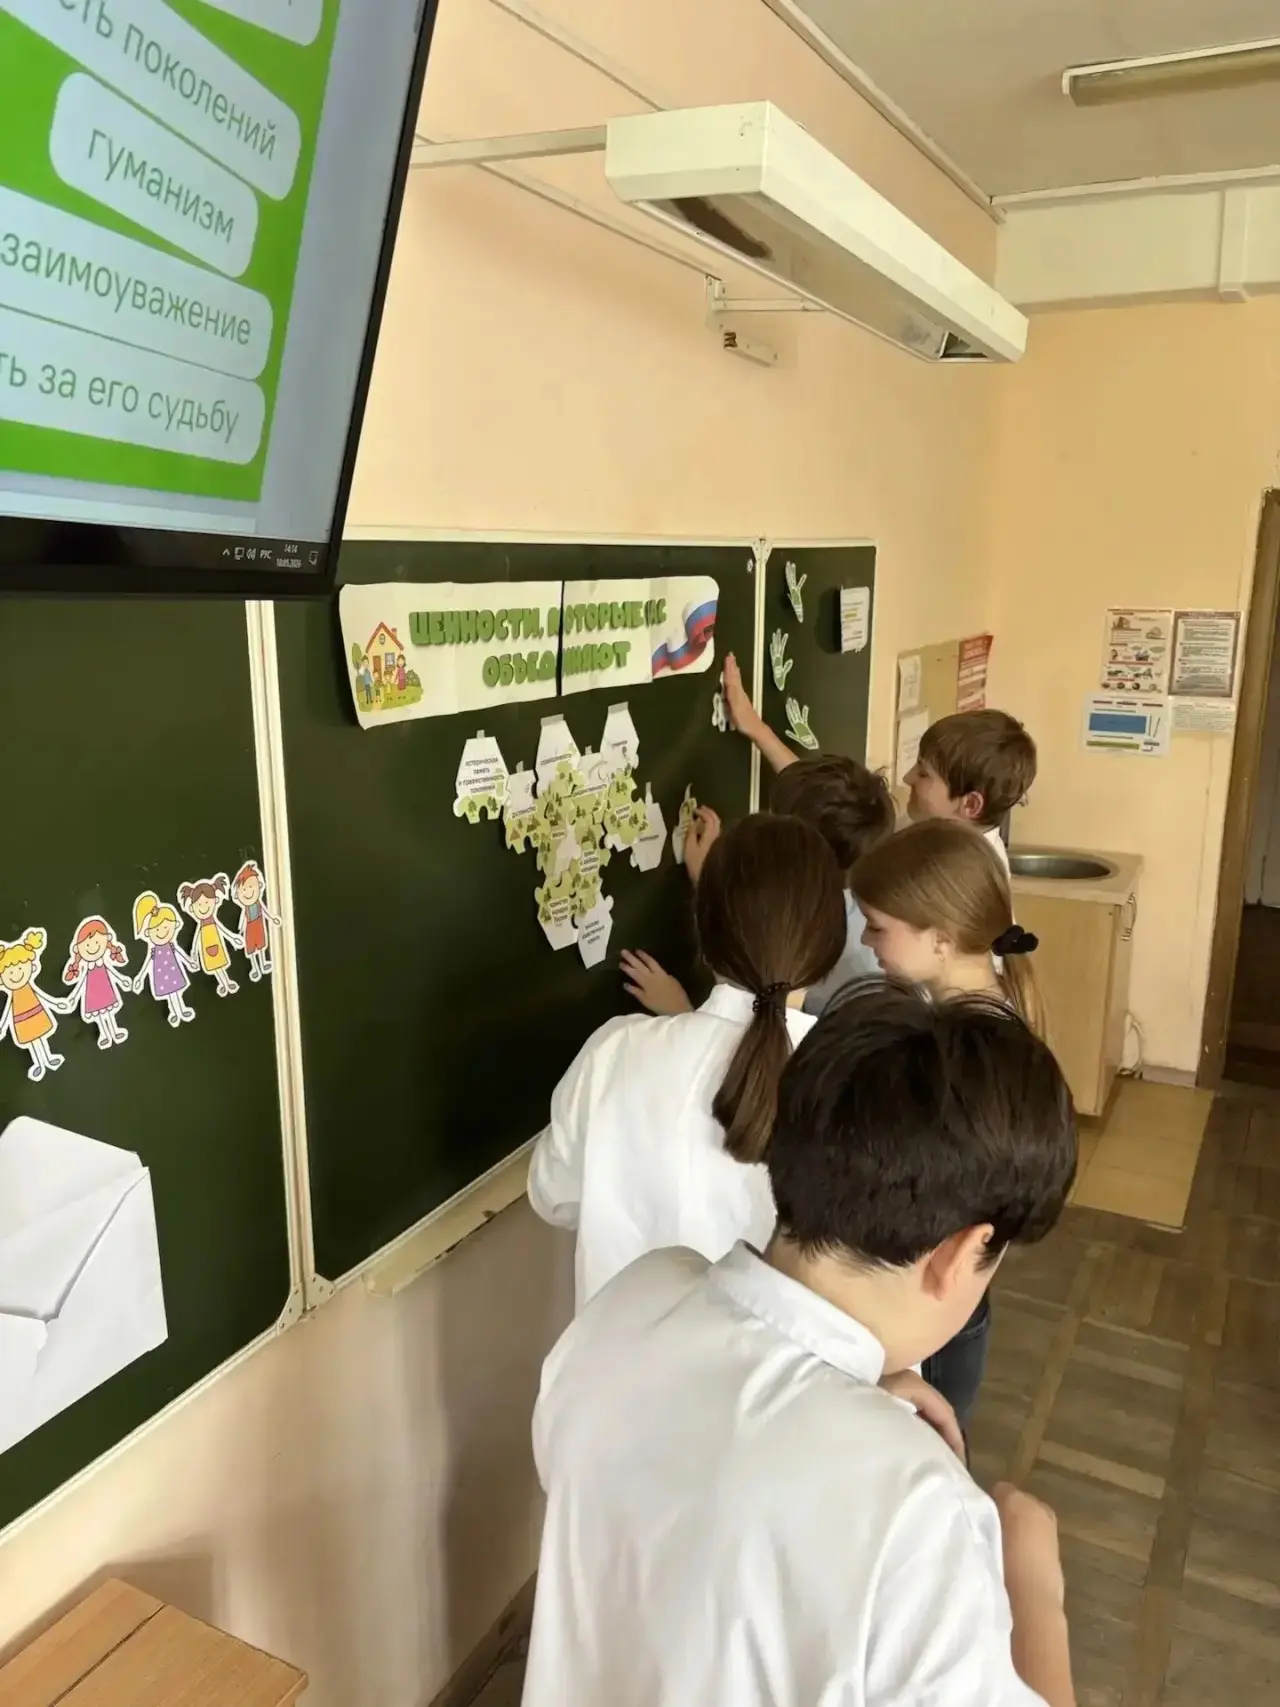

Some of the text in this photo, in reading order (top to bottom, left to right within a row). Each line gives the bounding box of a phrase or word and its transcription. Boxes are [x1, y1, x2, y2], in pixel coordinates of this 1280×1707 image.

[123, 23, 276, 161] поколений
[87, 129, 234, 244] гуманизм
[38, 364, 76, 399] за
[88, 376, 139, 413] его
[148, 391, 240, 444] судьбу
[408, 607, 544, 646] ЦЕННОСТИ,
